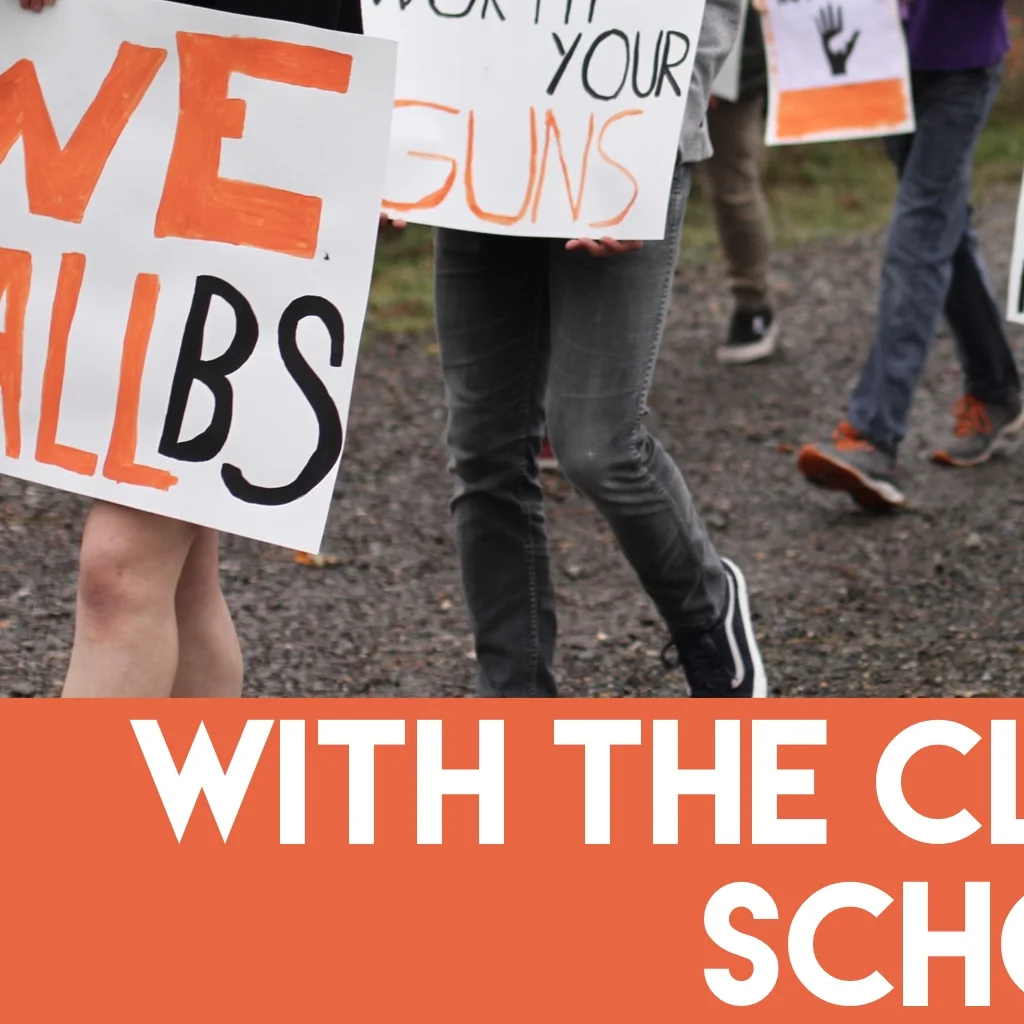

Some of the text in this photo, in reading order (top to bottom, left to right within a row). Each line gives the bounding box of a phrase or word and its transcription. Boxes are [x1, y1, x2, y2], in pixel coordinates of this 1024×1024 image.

[547, 28, 690, 100] YOUR
[381, 99, 644, 228] GUNS
[158, 275, 345, 507] BS
